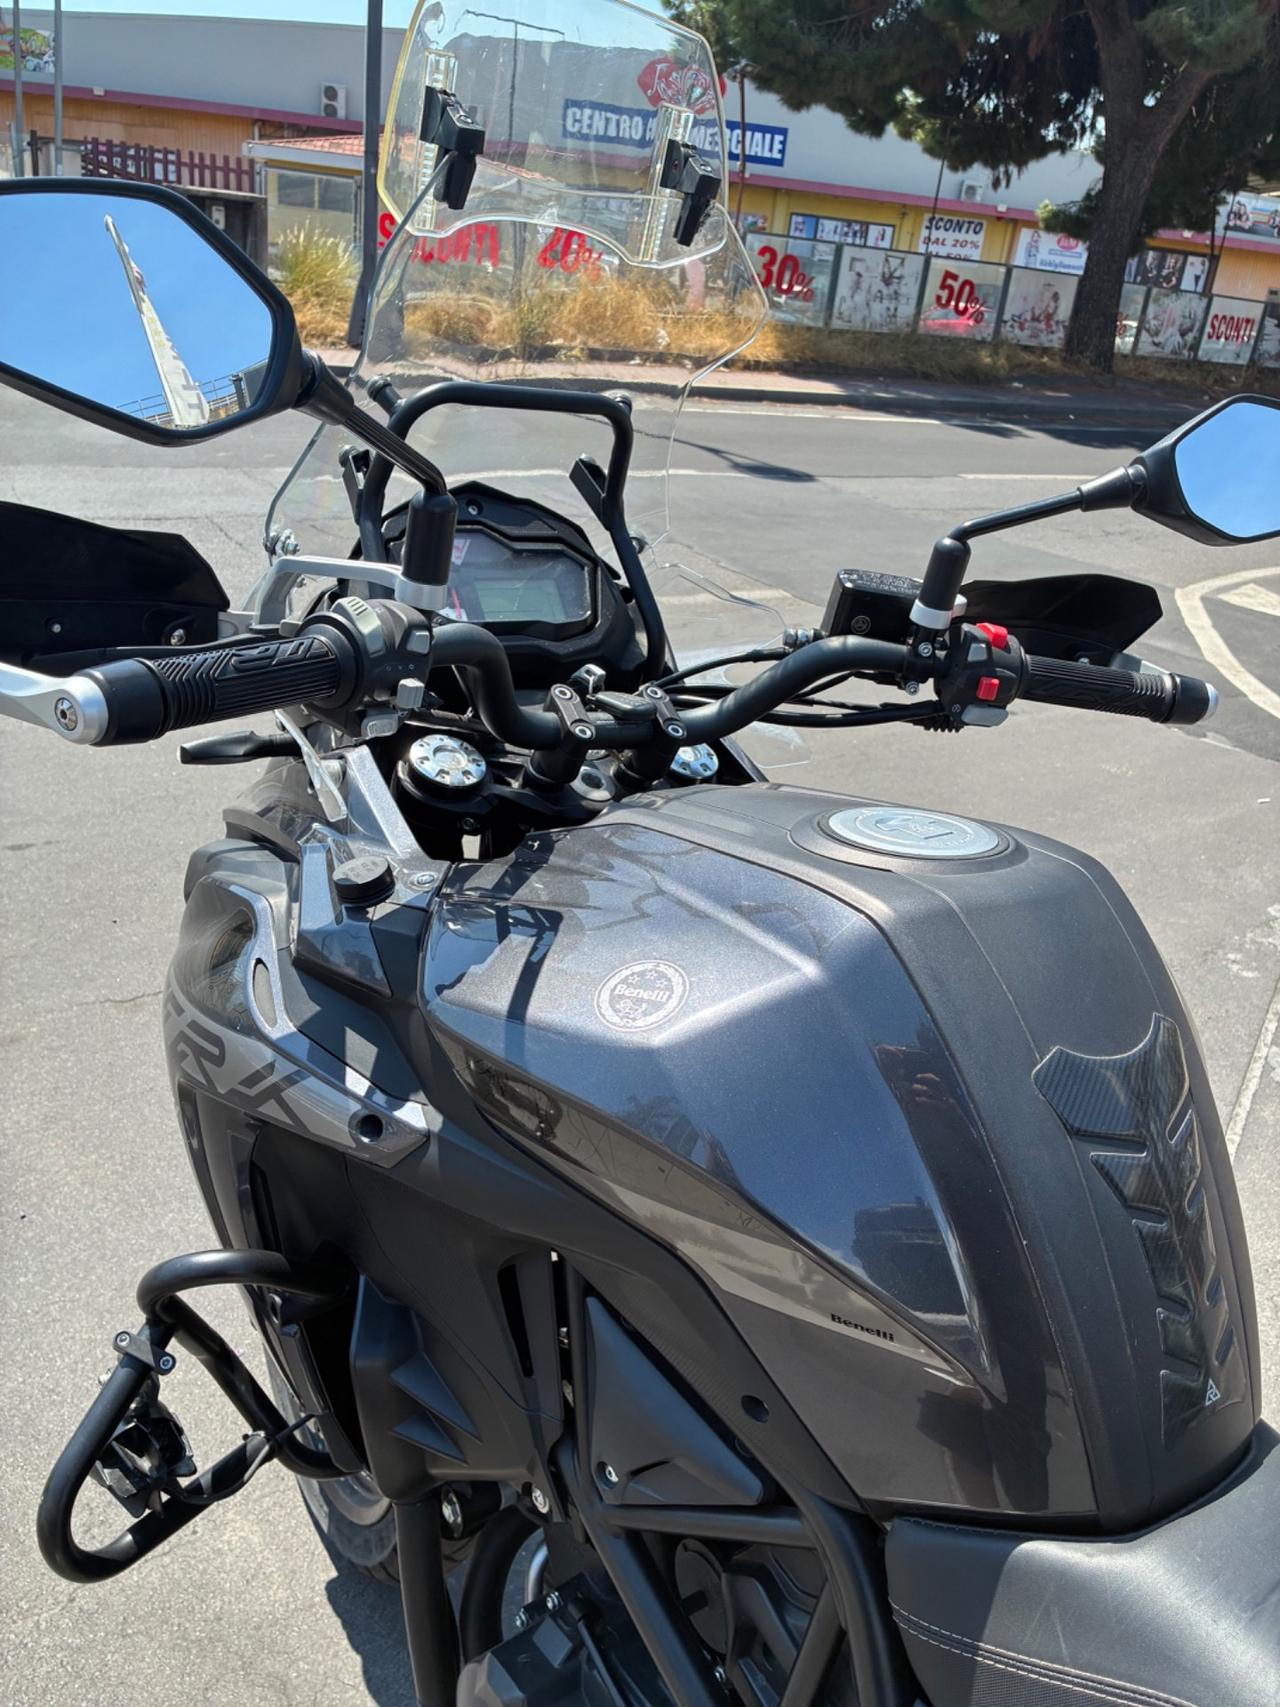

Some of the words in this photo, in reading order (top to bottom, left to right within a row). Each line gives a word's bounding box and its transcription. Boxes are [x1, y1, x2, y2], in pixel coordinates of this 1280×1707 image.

[565, 106, 643, 141] CENTRO
[646, 117, 784, 159] CMECIALE
[925, 216, 984, 235] SCONTO
[922, 236, 947, 247] DAL
[951, 238, 980, 250] 20%
[752, 245, 816, 303] 30%
[936, 270, 984, 324] 50%
[1208, 314, 1256, 343] SCONTI
[613, 983, 671, 1002] Benelli
[831, 1312, 894, 1342] Benelli
